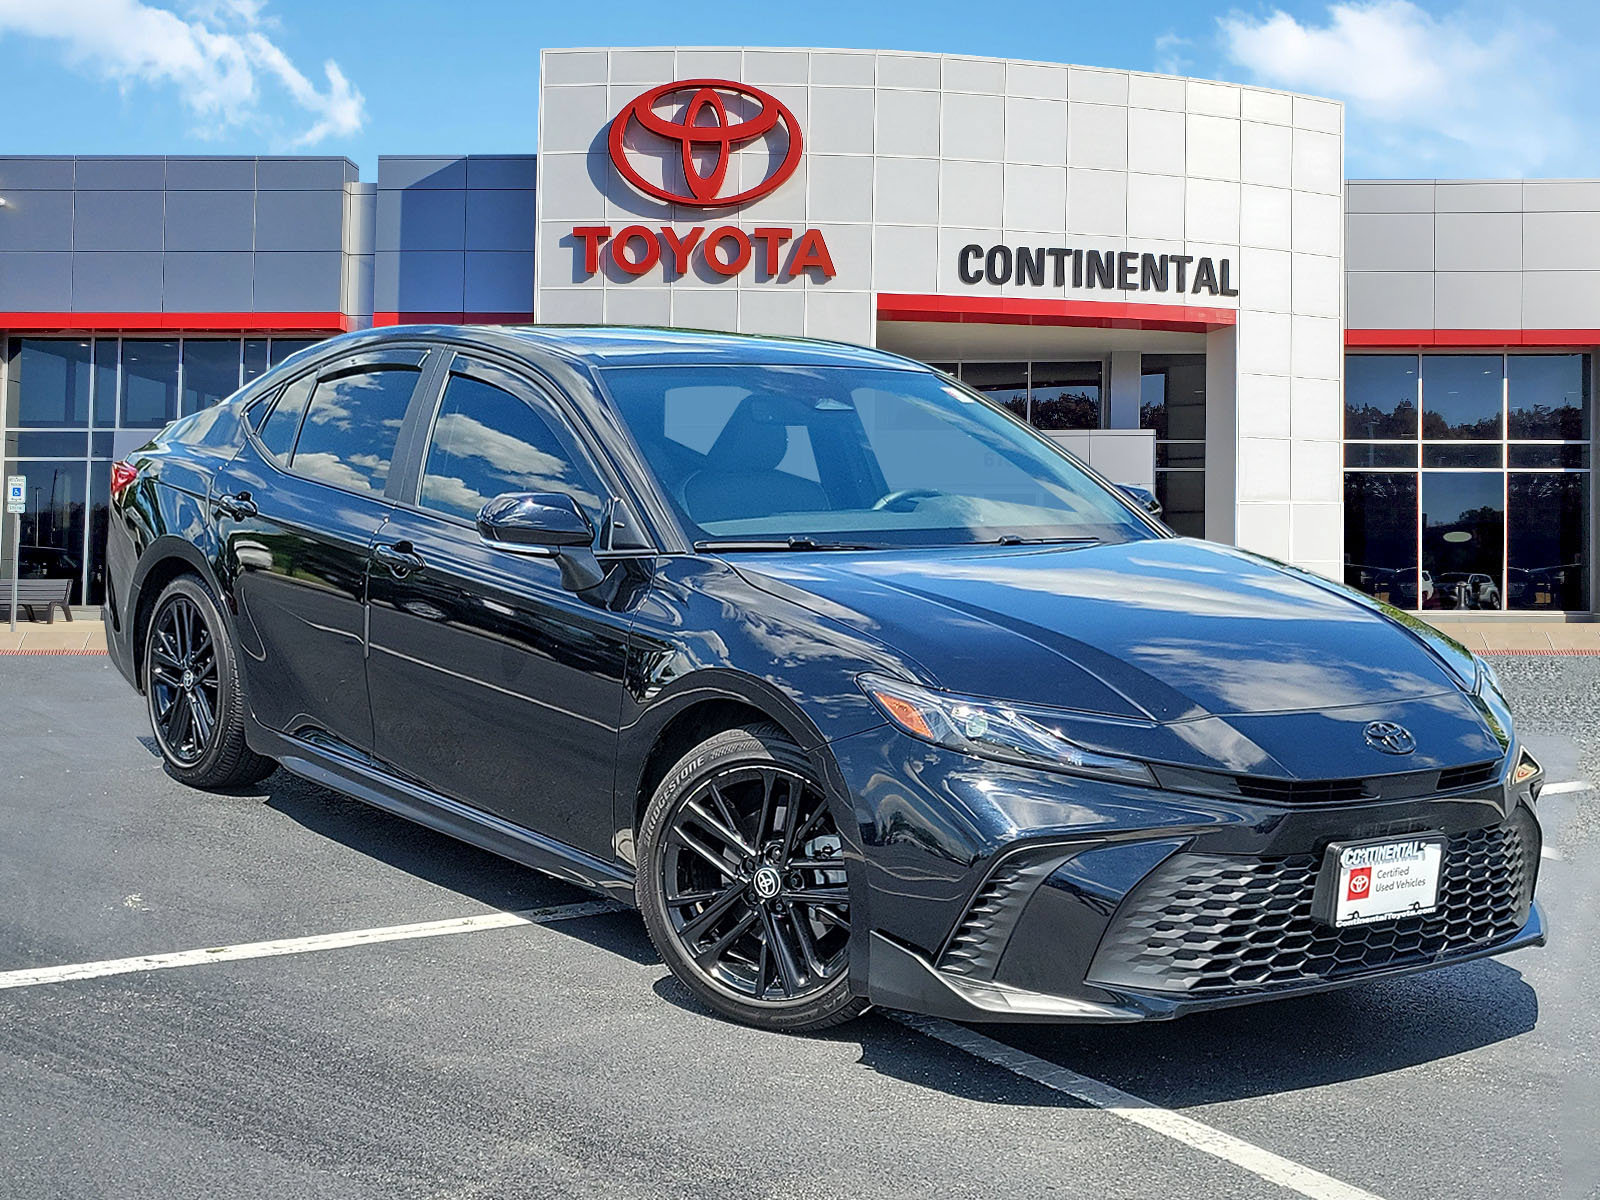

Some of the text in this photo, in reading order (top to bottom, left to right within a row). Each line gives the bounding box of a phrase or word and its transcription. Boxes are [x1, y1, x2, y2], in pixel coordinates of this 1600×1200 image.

[573, 225, 837, 277] TOYOTA
[959, 244, 1239, 297] CONTINENTAL
[1377, 866, 1410, 879] Certified
[1376, 878, 1426, 892] Used Vehicles
[1336, 907, 1436, 927] ContinentalToyota.com
